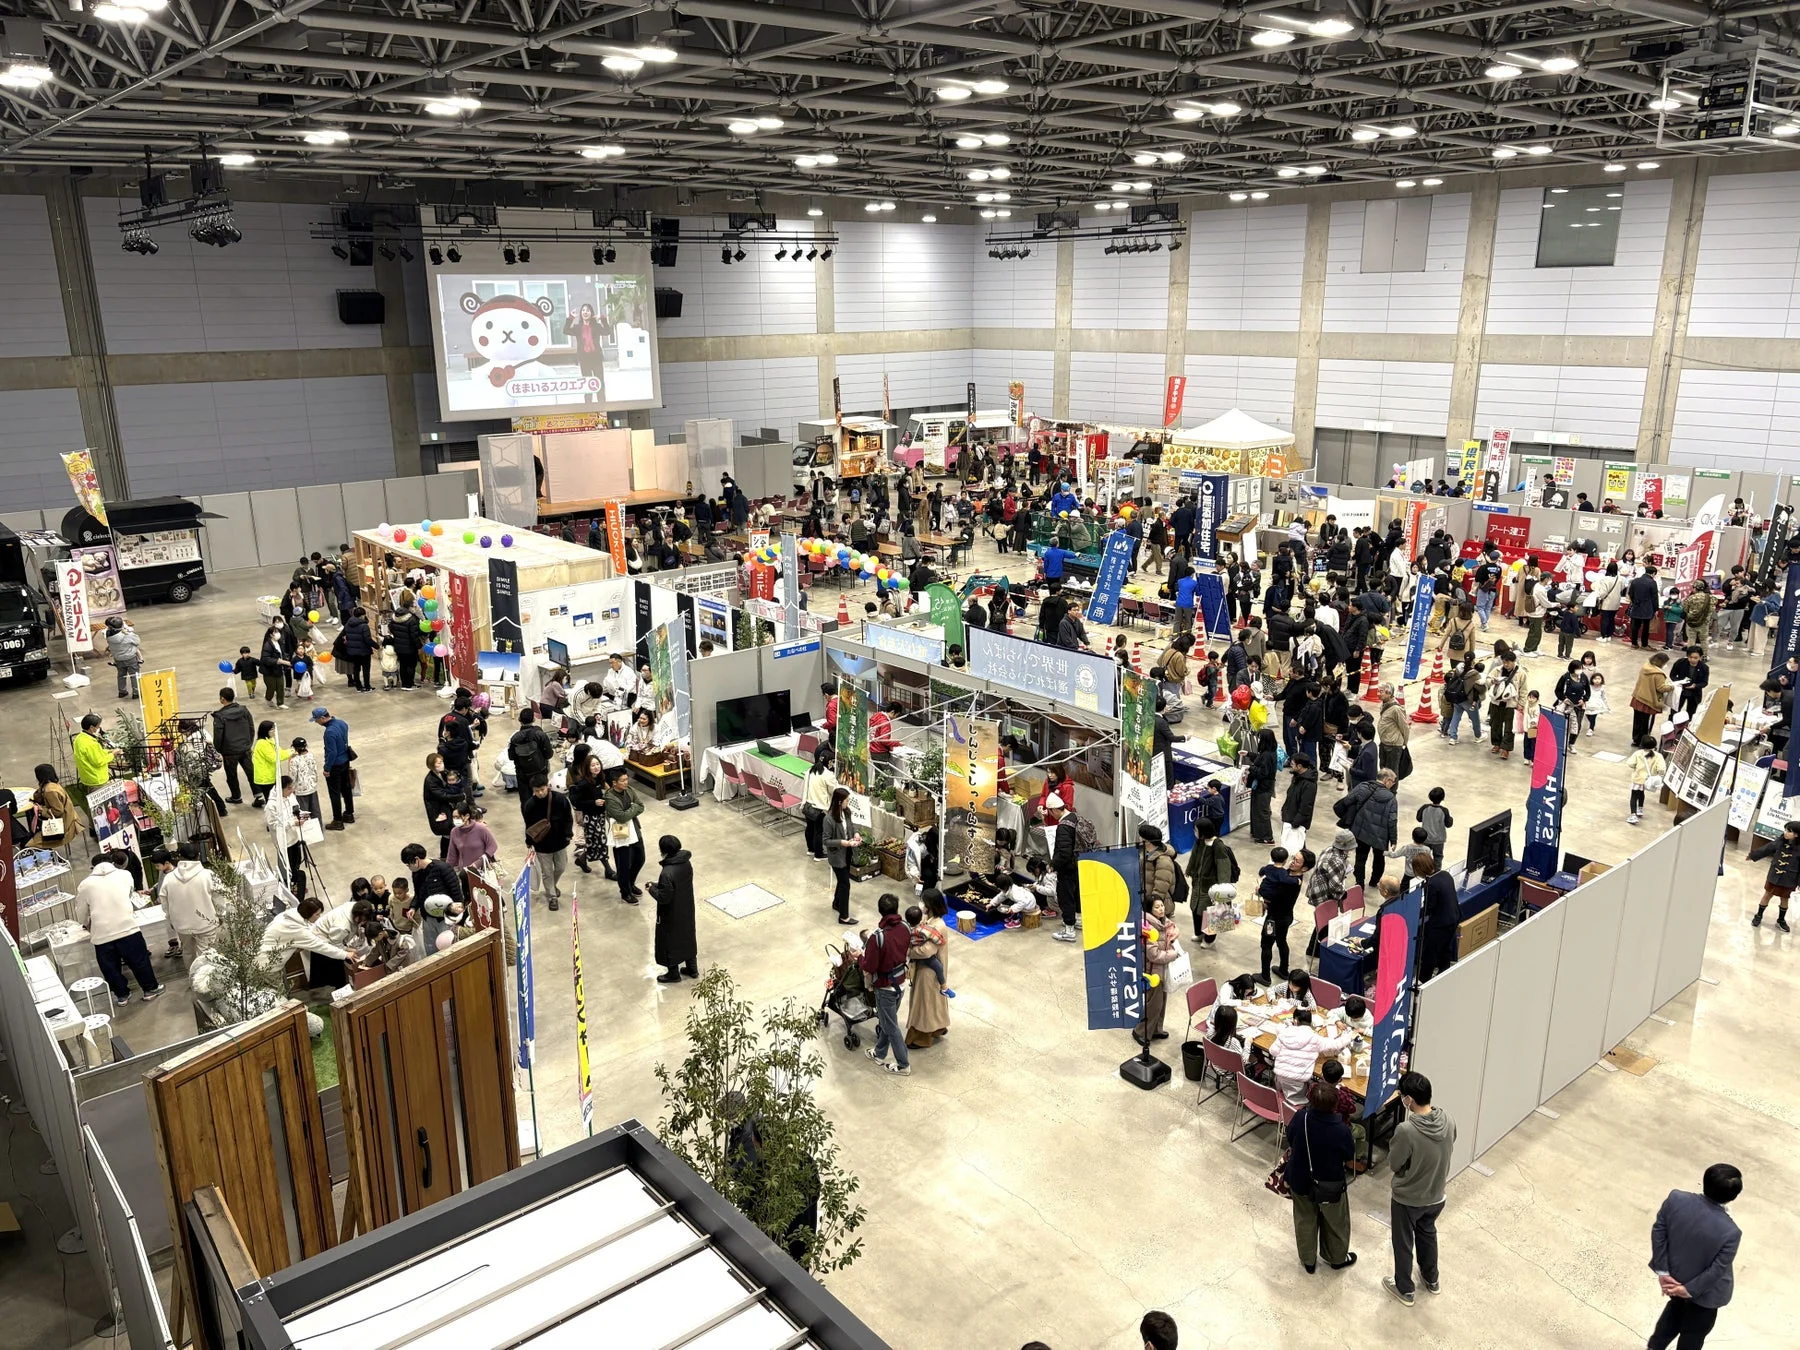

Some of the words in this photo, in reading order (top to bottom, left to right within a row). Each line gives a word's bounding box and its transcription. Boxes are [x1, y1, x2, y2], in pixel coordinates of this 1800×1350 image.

[511, 377, 586, 395] 住まいるスクエア
[1489, 523, 1526, 537] アート建工
[1103, 556, 1117, 591] 株式会社
[64, 594, 75, 639] DAISENHAM
[1092, 592, 1110, 619] 原商
[1787, 628, 1799, 652] HOUSE
[963, 723, 979, 867] しんじこしっちんすくい
[1183, 804, 1209, 825] ICHI
